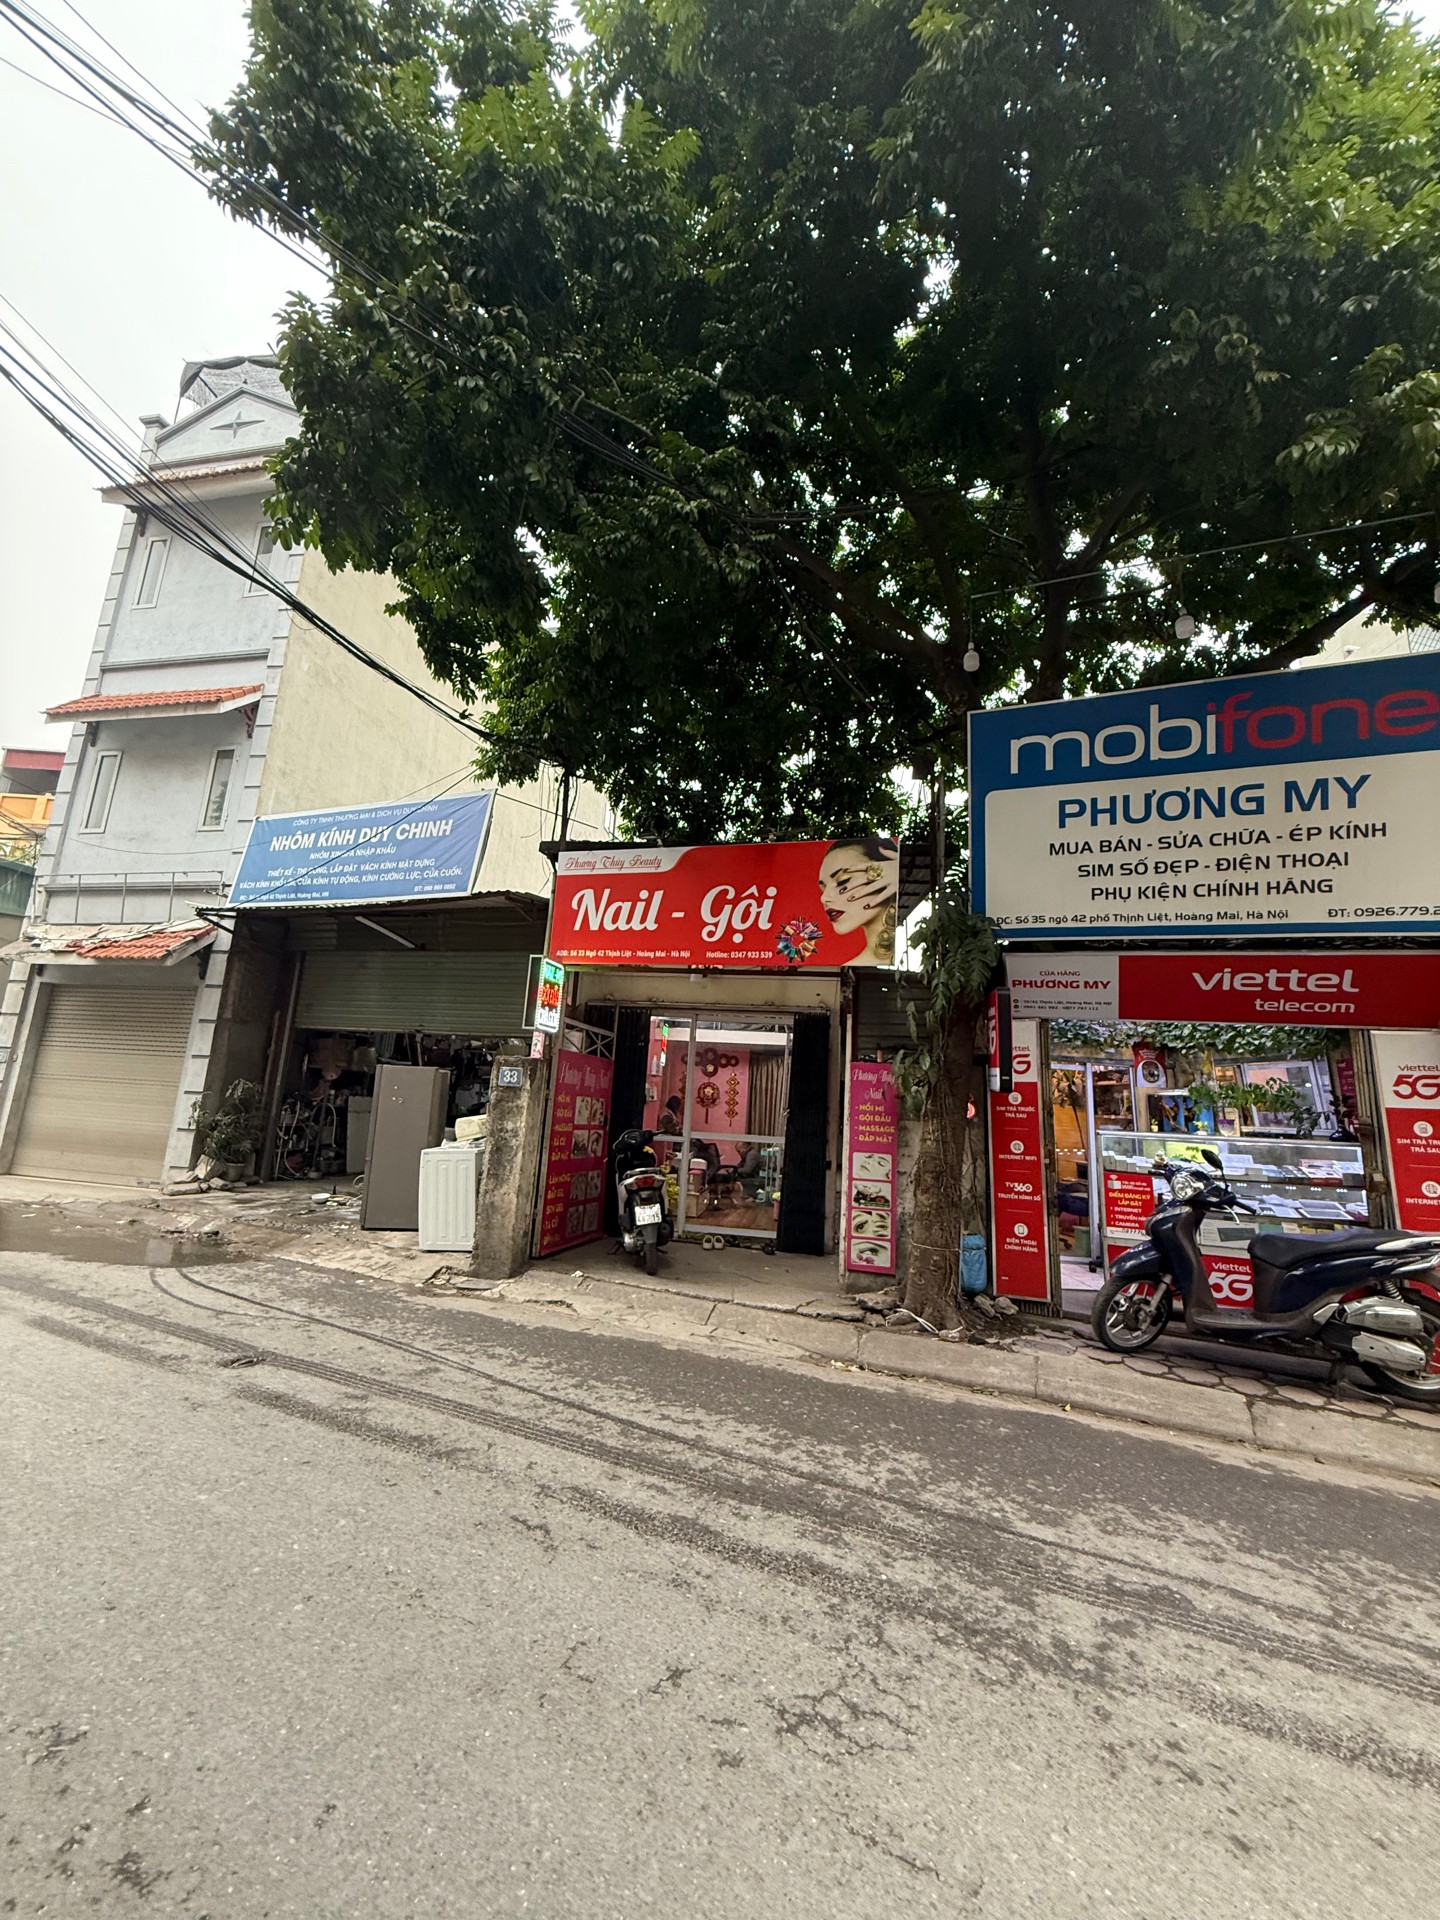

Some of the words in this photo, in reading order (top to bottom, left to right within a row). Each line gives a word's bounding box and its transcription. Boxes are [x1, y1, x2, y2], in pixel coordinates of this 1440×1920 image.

[1010, 689, 1440, 774] mobifone
[1058, 782, 1265, 829] PHƯƠNG
[1284, 774, 1372, 813] MY
[270, 830, 316, 851] NHÔM
[317, 827, 356, 847] KÍNH
[358, 825, 394, 844] DUY
[396, 819, 454, 840] CHINH
[1050, 841, 1094, 856] MUA
[1100, 835, 1142, 853] BÁN
[1158, 830, 1203, 849] SỬA
[1209, 828, 1271, 847] CHỮA
[1289, 824, 1323, 842] ÉP
[1329, 820, 1387, 840] KÍNH
[629, 854, 662, 870] Beauty
[1078, 863, 1114, 878] SIM
[1120, 857, 1149, 876] SỐ
[1154, 859, 1199, 876] ĐẸP
[1215, 853, 1271, 873] ĐIỆN
[1277, 851, 1349, 870] THOẠI
[1091, 886, 1131, 903] PHỤ
[1138, 882, 1187, 901] KIỆN
[1193, 879, 1259, 898] CHÍNH
[1266, 878, 1333, 895] HÃNG
[571, 888, 665, 932] Nail
[671, 911, 685, 919] -
[700, 884, 778, 944] Gội
[1015, 915, 1029, 924] Số
[1031, 916, 1046, 924] 35
[1071, 914, 1087, 923] 42
[1090, 913, 1110, 924] phố
[1112, 913, 1144, 924] Thịnh
[1147, 912, 1172, 923] Liệt,
[1175, 912, 1213, 922] Hoàng
[1217, 911, 1243, 921] Mai,
[1247, 910, 1263, 920] Hà
[1267, 909, 1289, 920] Nội
[1328, 908, 1350, 918] ĐT:
[636, 950, 654, 958] Hoàng
[731, 951, 746, 959] 0347
[747, 951, 759, 959] 933
[760, 951, 773, 959] 539
[1012, 979, 1080, 989] PHƯƠNG
[1084, 980, 1111, 989] MY
[1192, 968, 1360, 993] viettel
[1254, 998, 1356, 1013] telecom
[503, 1070, 518, 1082] 33
[1392, 1074, 1440, 1100] 5G
[859, 1102, 874, 1111] NỐI
[859, 1113, 874, 1123] GỘI
[875, 1112, 891, 1122] ĐẦU
[859, 1125, 896, 1133] MASSAGE
[858, 1132, 875, 1142] ĐẮP
[1005, 1182, 1033, 1193] TV360
[1211, 1262, 1252, 1273] viettel
[1207, 1271, 1254, 1301] 5G
